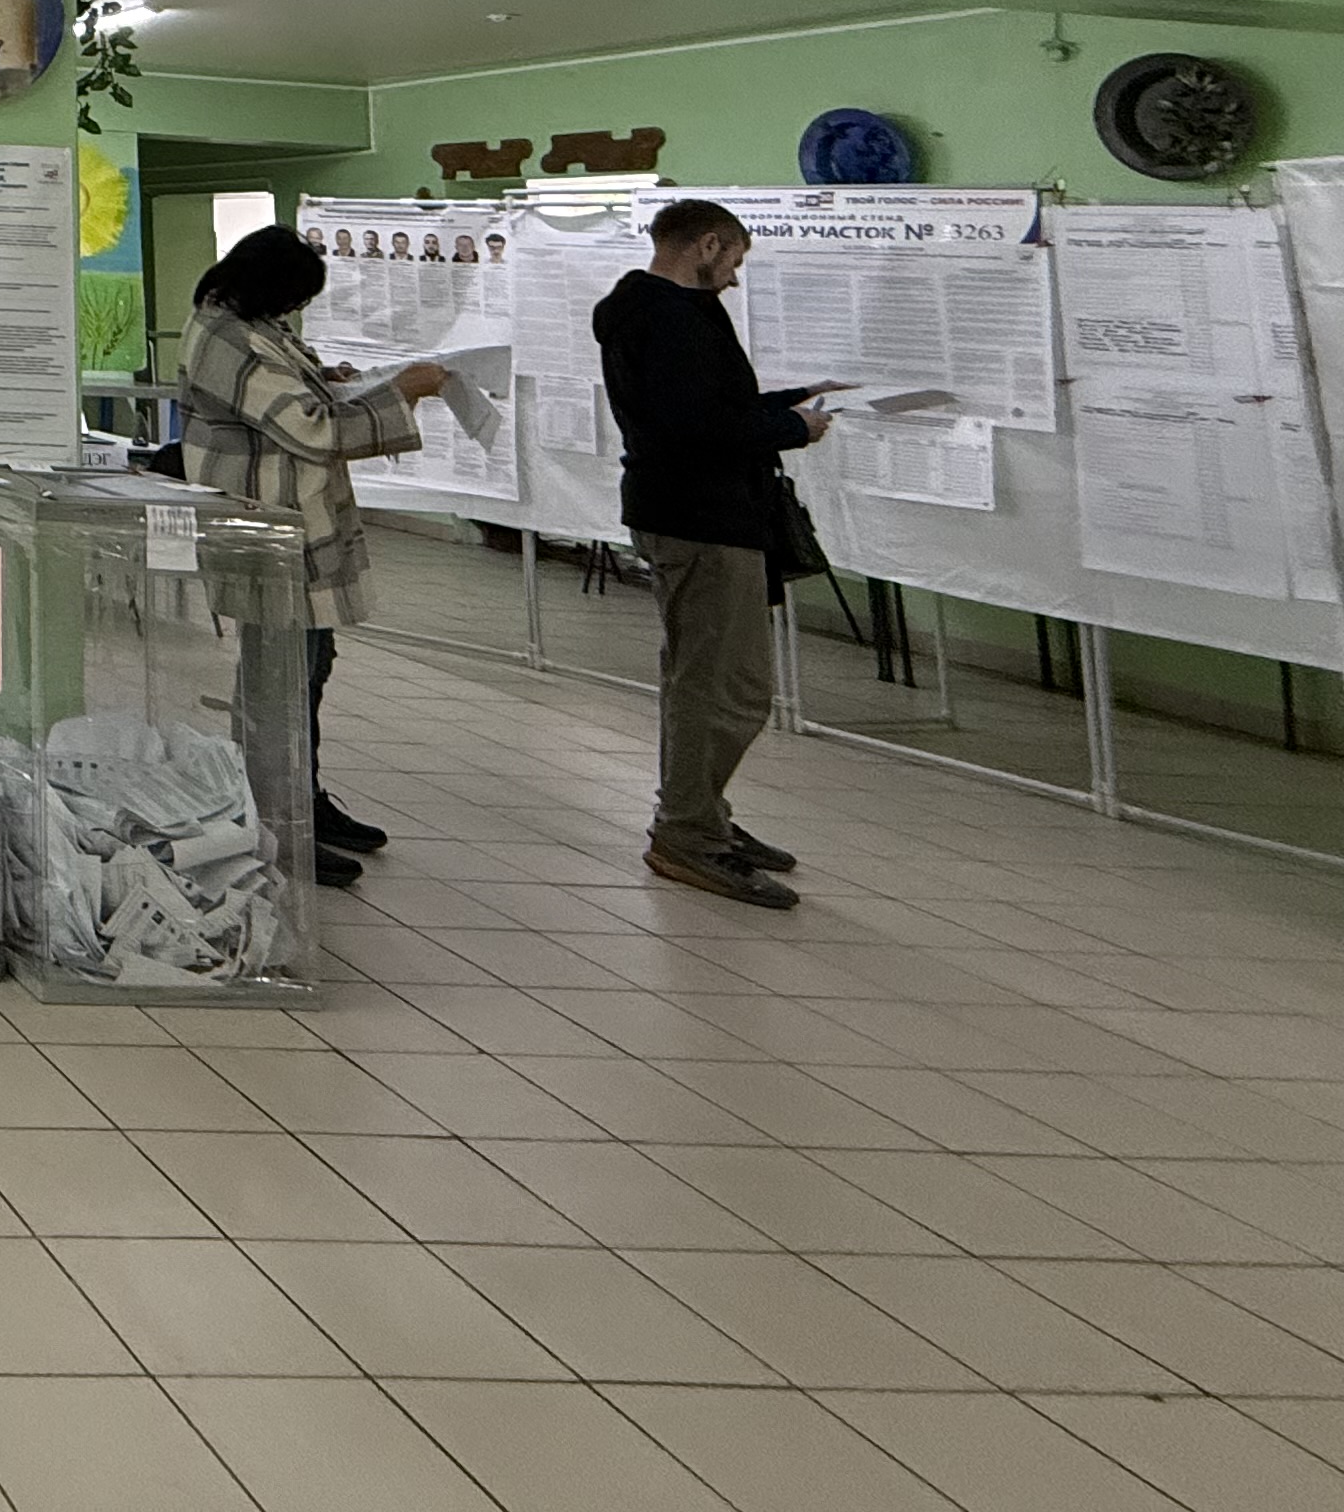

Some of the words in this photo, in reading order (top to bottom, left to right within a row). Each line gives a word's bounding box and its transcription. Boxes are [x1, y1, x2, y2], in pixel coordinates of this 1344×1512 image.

[844, 195, 875, 204] ТВОЙ
[878, 197, 917, 205] ГОЛОС
[861, 214, 904, 222] СТЕНД
[799, 225, 896, 239] УЧАСТОК
[905, 224, 934, 240] №
[951, 224, 1006, 240] 3263
